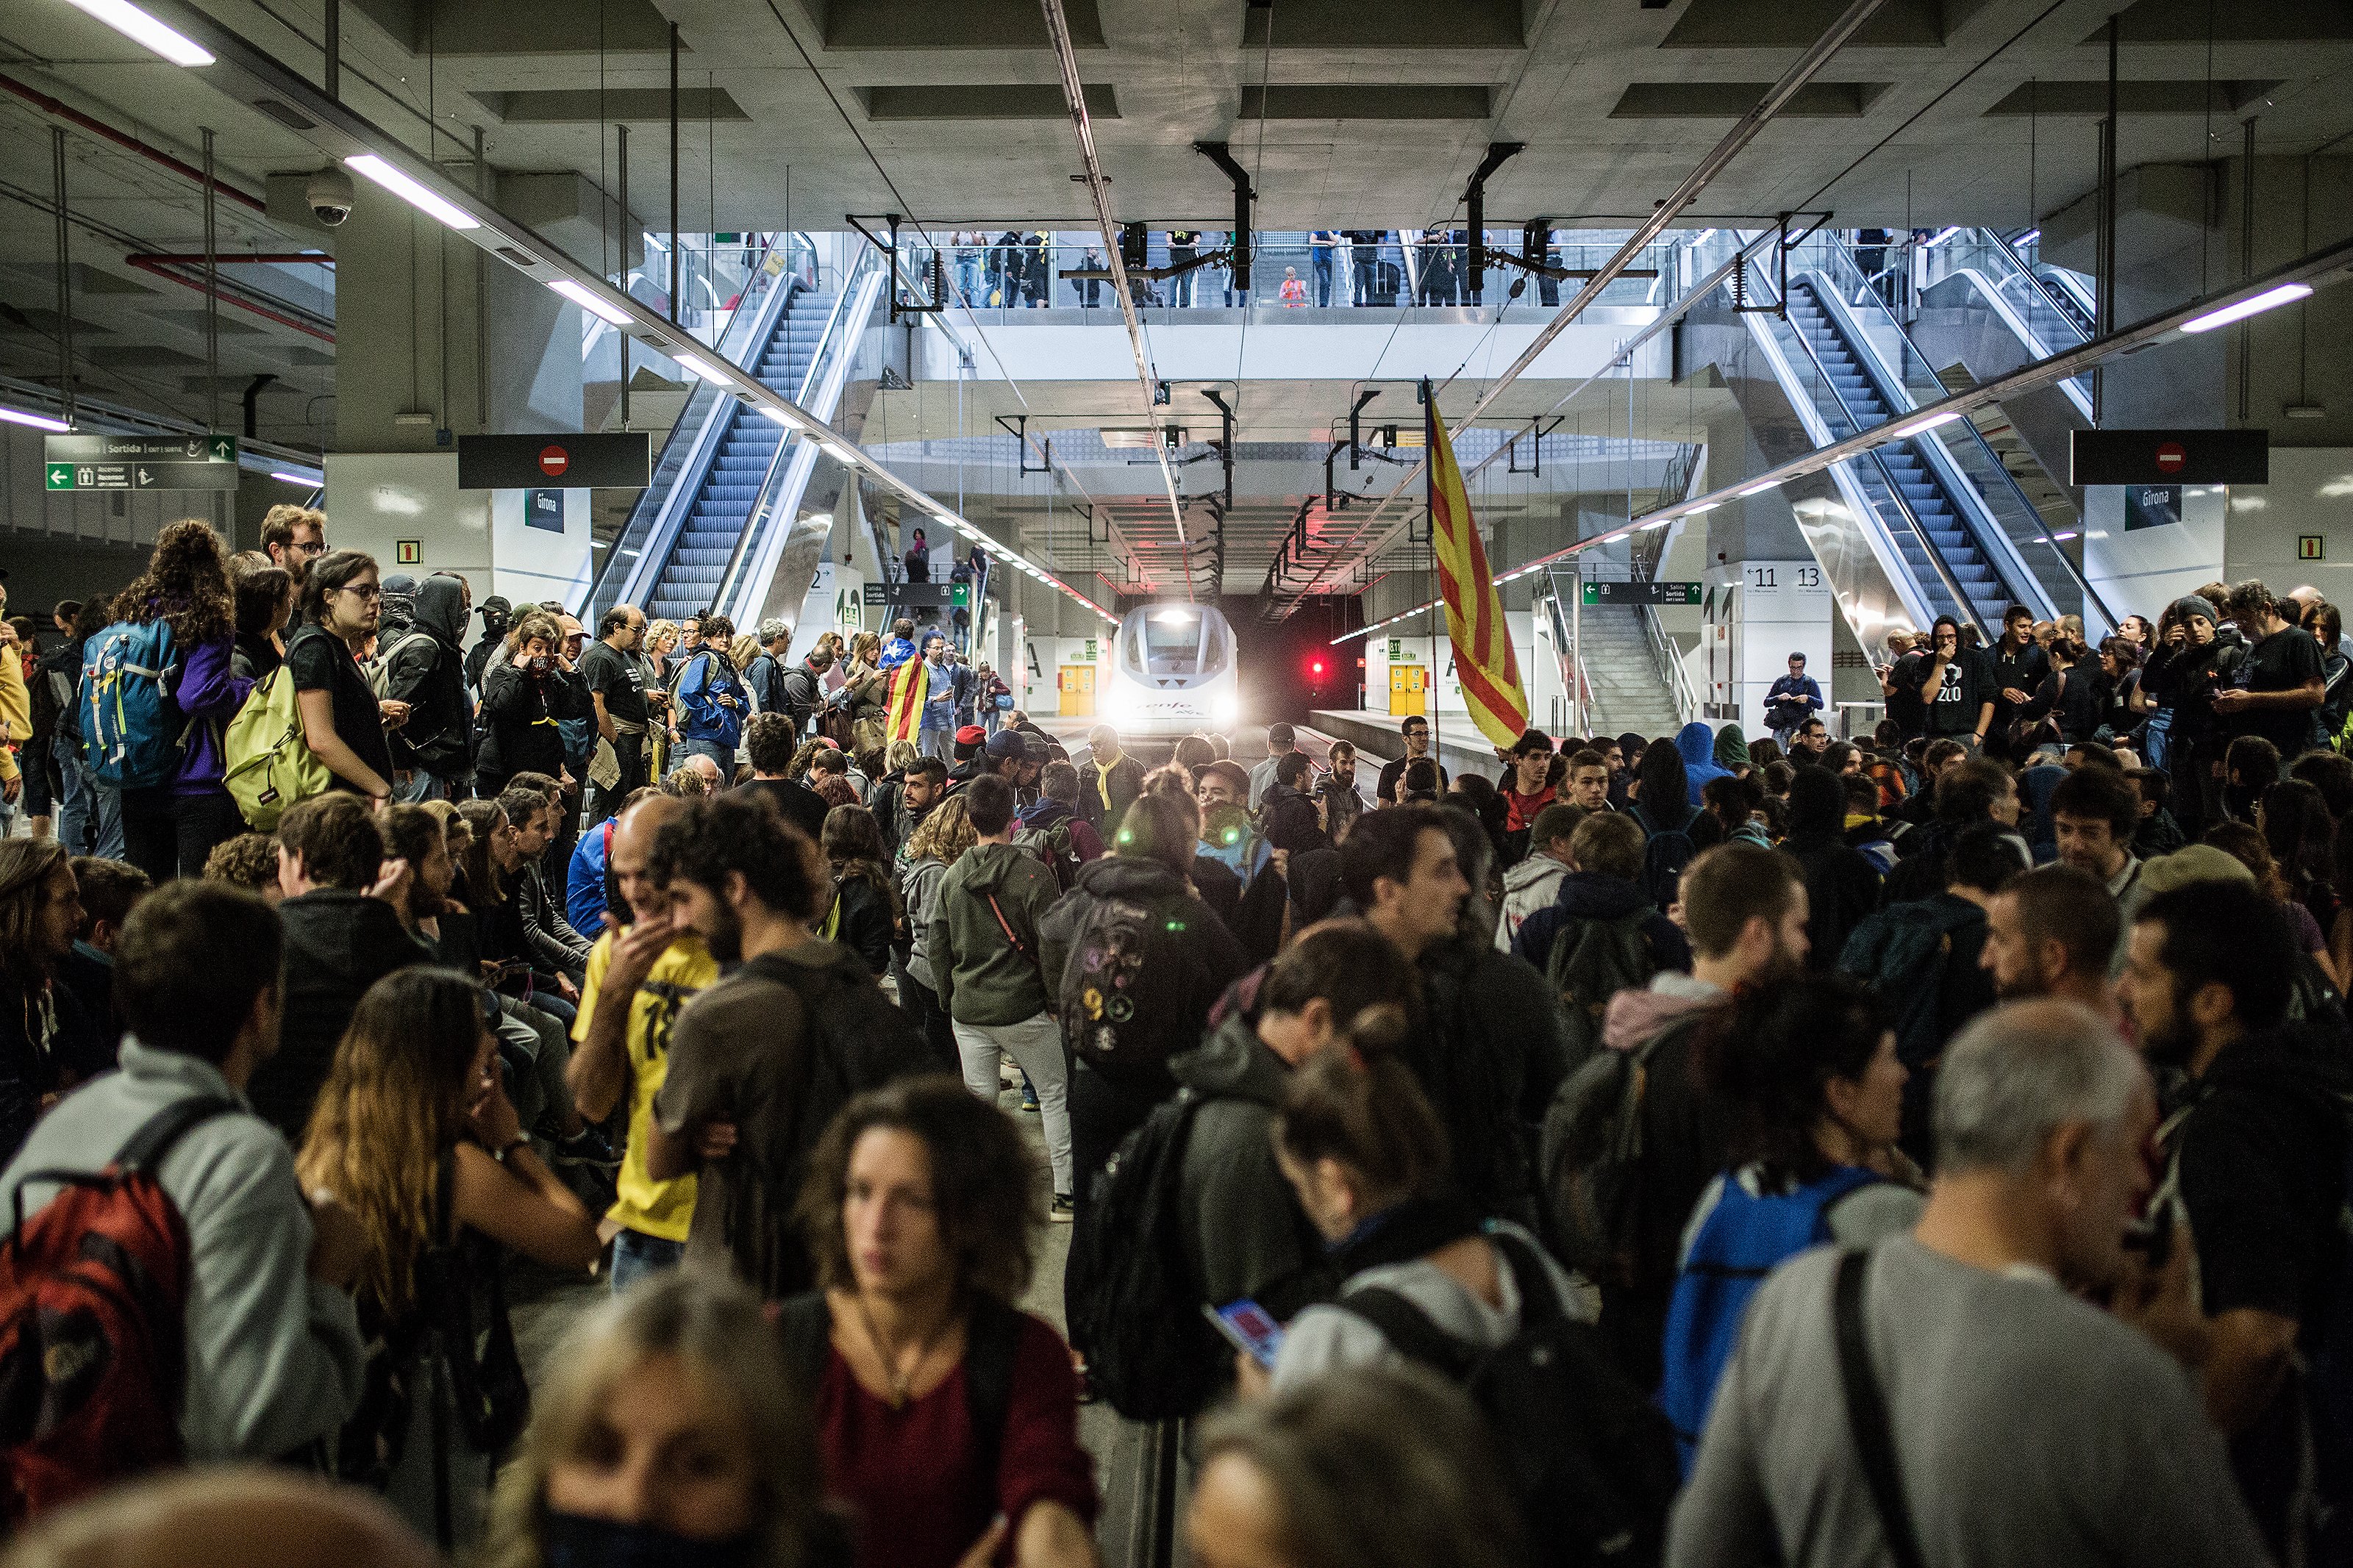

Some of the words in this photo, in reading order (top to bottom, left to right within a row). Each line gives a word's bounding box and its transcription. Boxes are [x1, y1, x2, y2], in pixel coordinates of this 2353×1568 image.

[108, 444, 141, 454] Sortida
[537, 492, 557, 512] Girona
[2143, 489, 2170, 507] Girona
[1755, 568, 1778, 587] 11
[1797, 568, 1820, 587] 13
[1390, 642, 1400, 652] 8.11
[1026, 642, 1043, 678] A
[1937, 687, 1962, 702] ZOO
